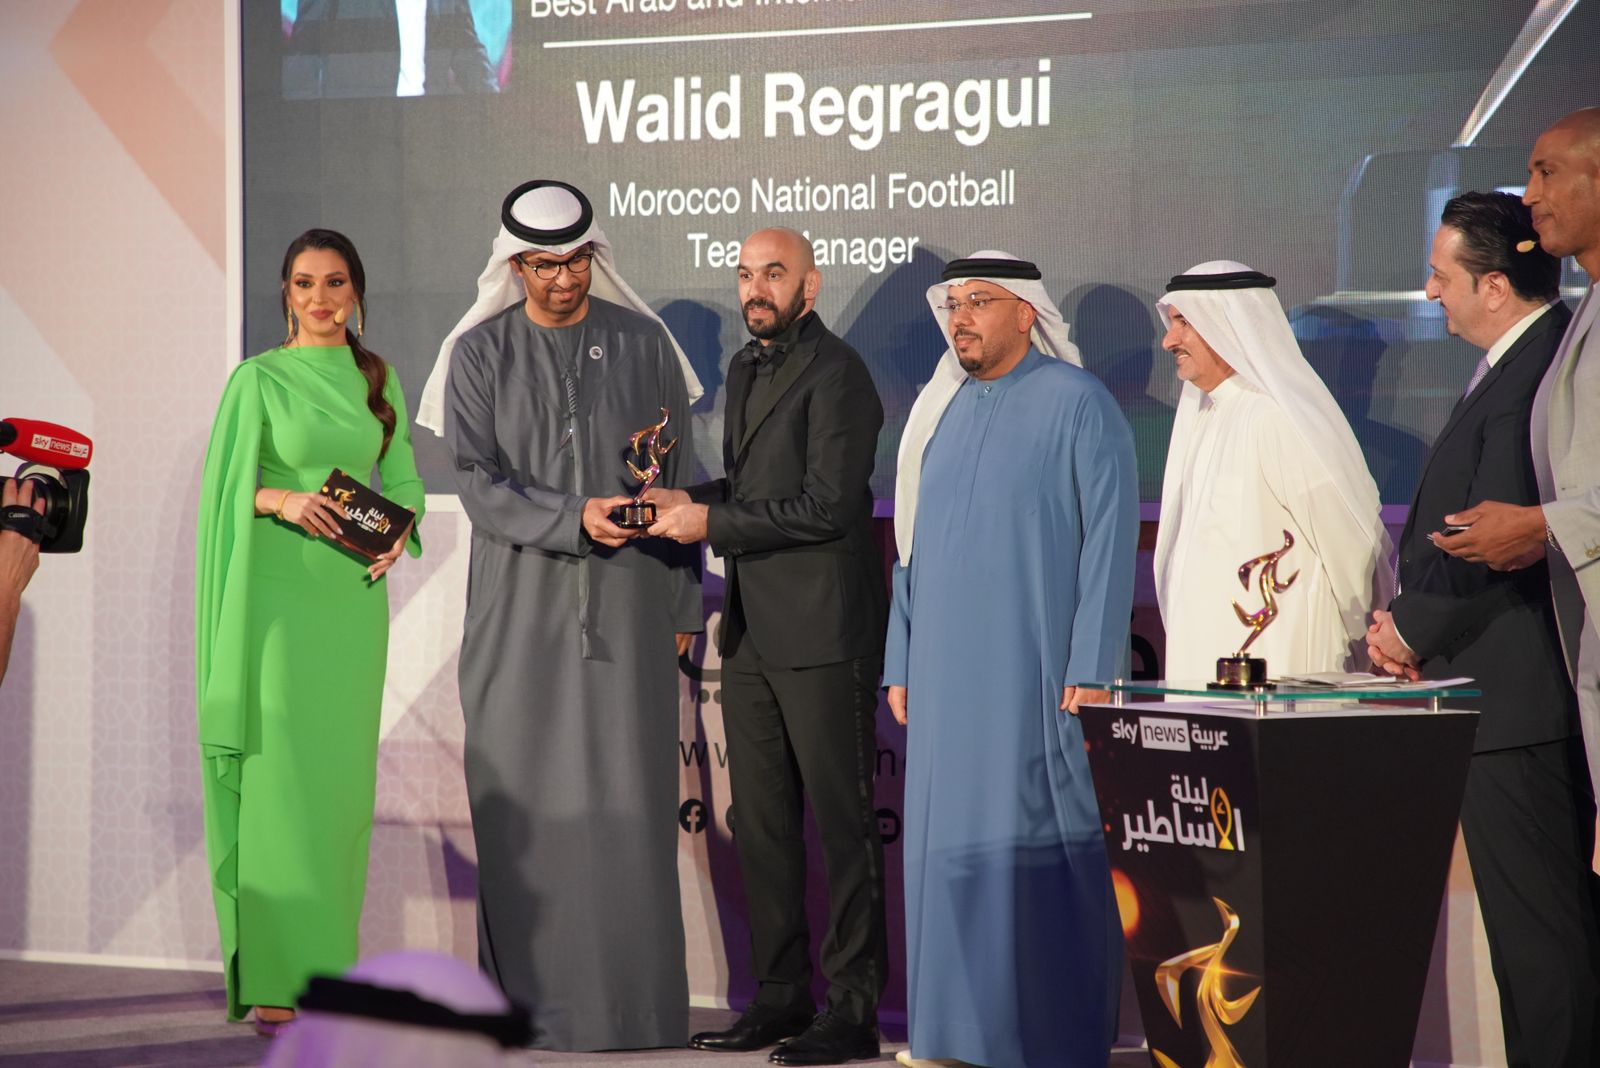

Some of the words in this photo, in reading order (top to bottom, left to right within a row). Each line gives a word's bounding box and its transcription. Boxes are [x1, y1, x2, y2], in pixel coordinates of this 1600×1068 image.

[576, 74, 741, 144] Walid
[765, 59, 1050, 150] Regragui
[610, 182, 740, 217] Morocco
[751, 174, 876, 213] National
[888, 169, 1015, 209] Football
[687, 233, 741, 268] Tea
[804, 230, 920, 274] anager
[34, 436, 49, 448] sky
[50, 441, 71, 452] news
[1112, 718, 1138, 744] sky
[1143, 724, 1186, 743] news
[1191, 723, 1229, 751] عربية
[1170, 774, 1209, 813] ليلة
